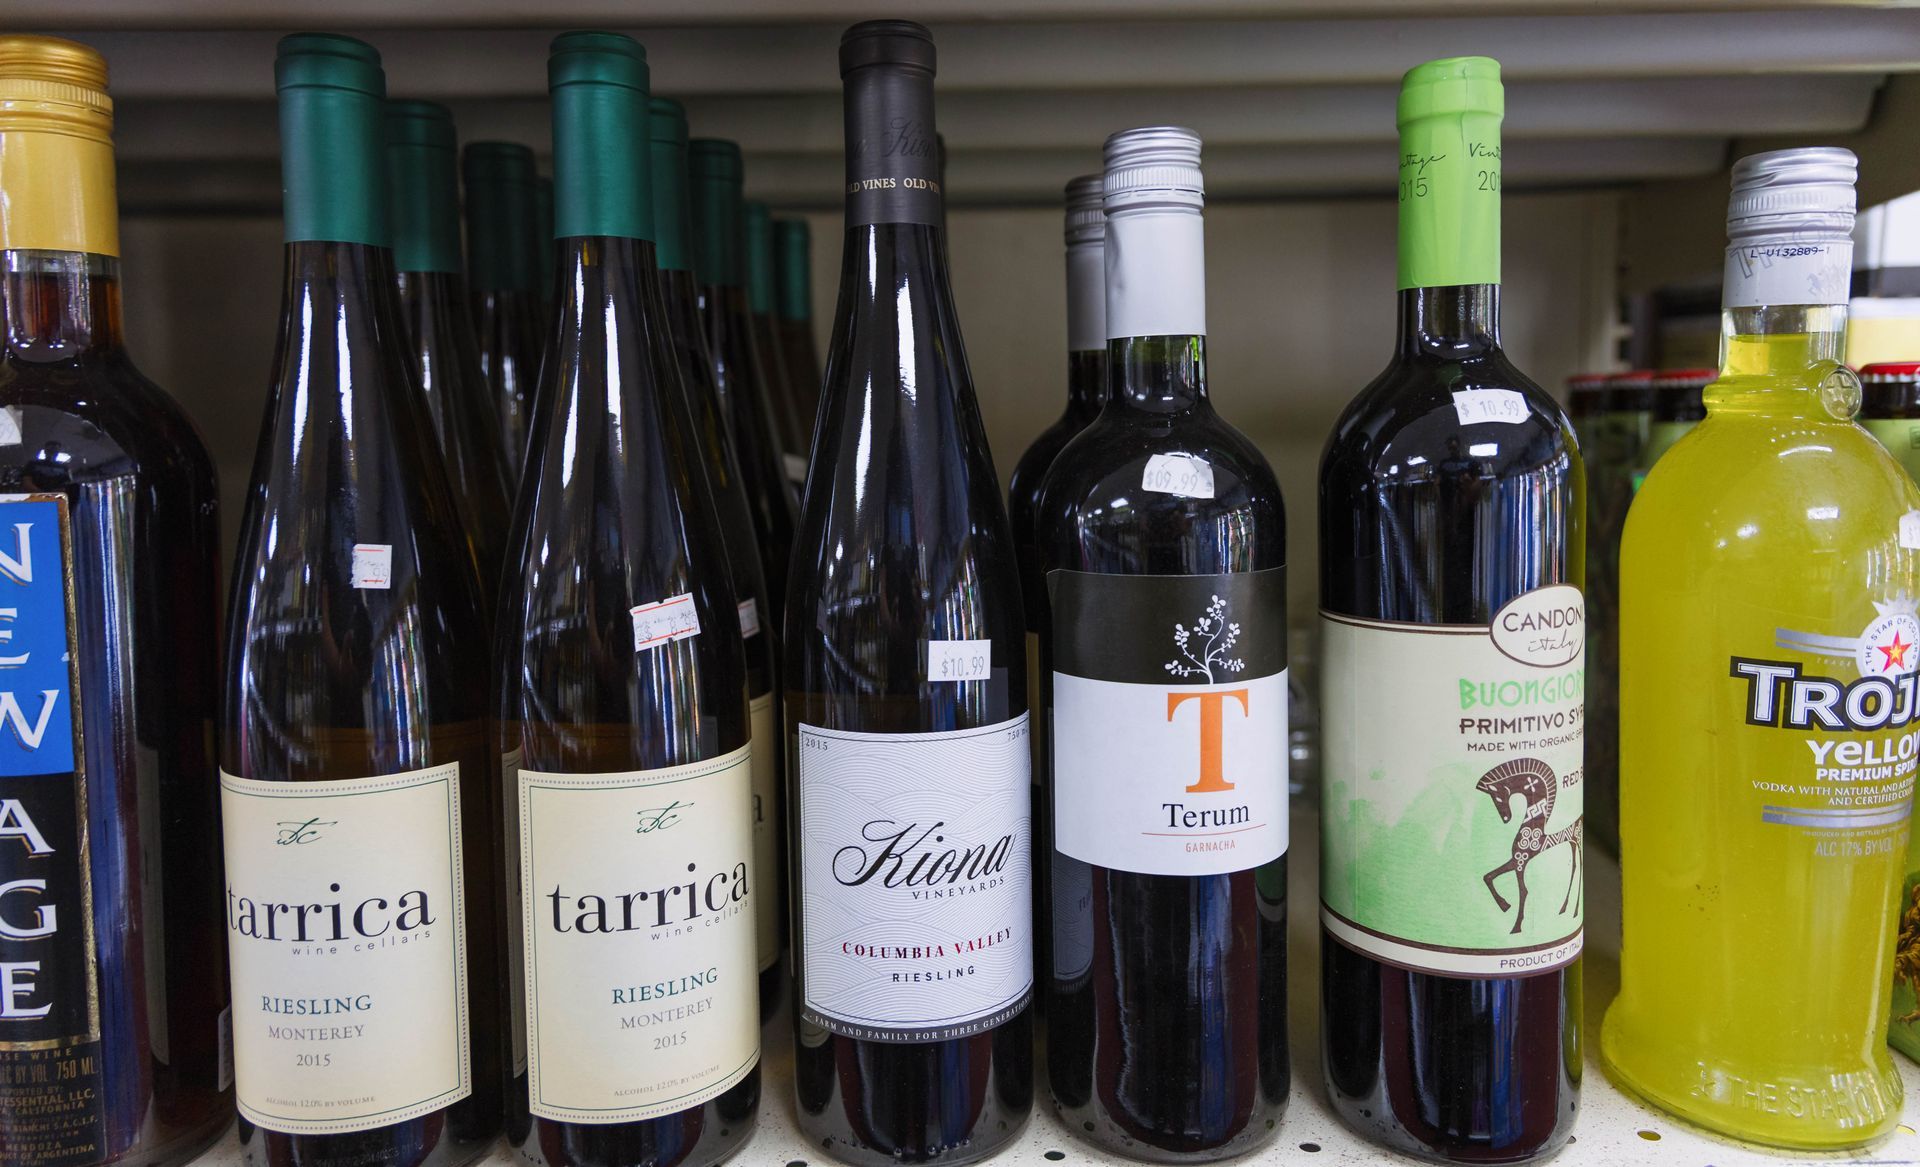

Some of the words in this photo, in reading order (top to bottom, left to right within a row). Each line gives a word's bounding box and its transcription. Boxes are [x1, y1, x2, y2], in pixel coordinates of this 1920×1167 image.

[863, 177, 896, 190] VINES
[904, 177, 926, 189] OLD
[1871, 619, 1893, 641] STAR
[941, 655, 985, 677] $10.99
[1459, 712, 1564, 735] PRIMITIVO
[805, 737, 828, 751] 2015
[1168, 688, 1248, 793] T
[1467, 742, 1505, 751] MADE
[1509, 740, 1536, 751] WITH
[1540, 732, 1575, 748] ORGANIC
[1563, 770, 1580, 788] RED
[1816, 764, 1892, 782] PREMIUM
[1752, 780, 1795, 793] VODKA
[1799, 785, 1831, 796] WITH
[1835, 784, 1878, 796] NATURAL
[1881, 782, 1898, 793] AND
[1828, 796, 1853, 806] AND
[1855, 792, 1898, 806] CERTIFIED
[1162, 803, 1250, 828] Terum
[832, 820, 1017, 889] Kiona
[1186, 840, 1236, 853] GARNACHA
[1814, 841, 1837, 857] ALC
[911, 874, 1004, 900] VINEYARDS
[546, 862, 750, 934] tarrica
[227, 882, 437, 942] tarrica
[650, 923, 693, 941] wine
[705, 899, 749, 929] cellars
[292, 945, 338, 955] wine
[354, 929, 431, 952] cellars
[842, 941, 945, 960] COLUMBIA
[954, 926, 1012, 955] VALLEY
[1500, 952, 1553, 968] PRODUCT
[1556, 948, 1568, 959] OF
[892, 965, 976, 983] RIESLING
[612, 967, 719, 1004] RIESLING
[261, 994, 373, 1015] RIESLING
[620, 996, 714, 1030] MONTEREY
[268, 1024, 366, 1041] MONTEREY
[815, 1015, 837, 1031] FARM
[841, 1026, 862, 1038] AND
[867, 1030, 910, 1041] FAMILY
[915, 1030, 938, 1041] FOR
[944, 1023, 978, 1038] THREE
[653, 1030, 688, 1050] 2015
[31, 1047, 72, 1061] WINE
[295, 1053, 332, 1068] 2015
[57, 1059, 77, 1080] 750
[615, 1085, 654, 1097] ALCOHOL
[680, 1076, 690, 1085] BY
[337, 1096, 377, 1106] VOLUME
[6, 1141, 62, 1152] MENDOZA
[36, 1143, 95, 1160] ARGENTINA
